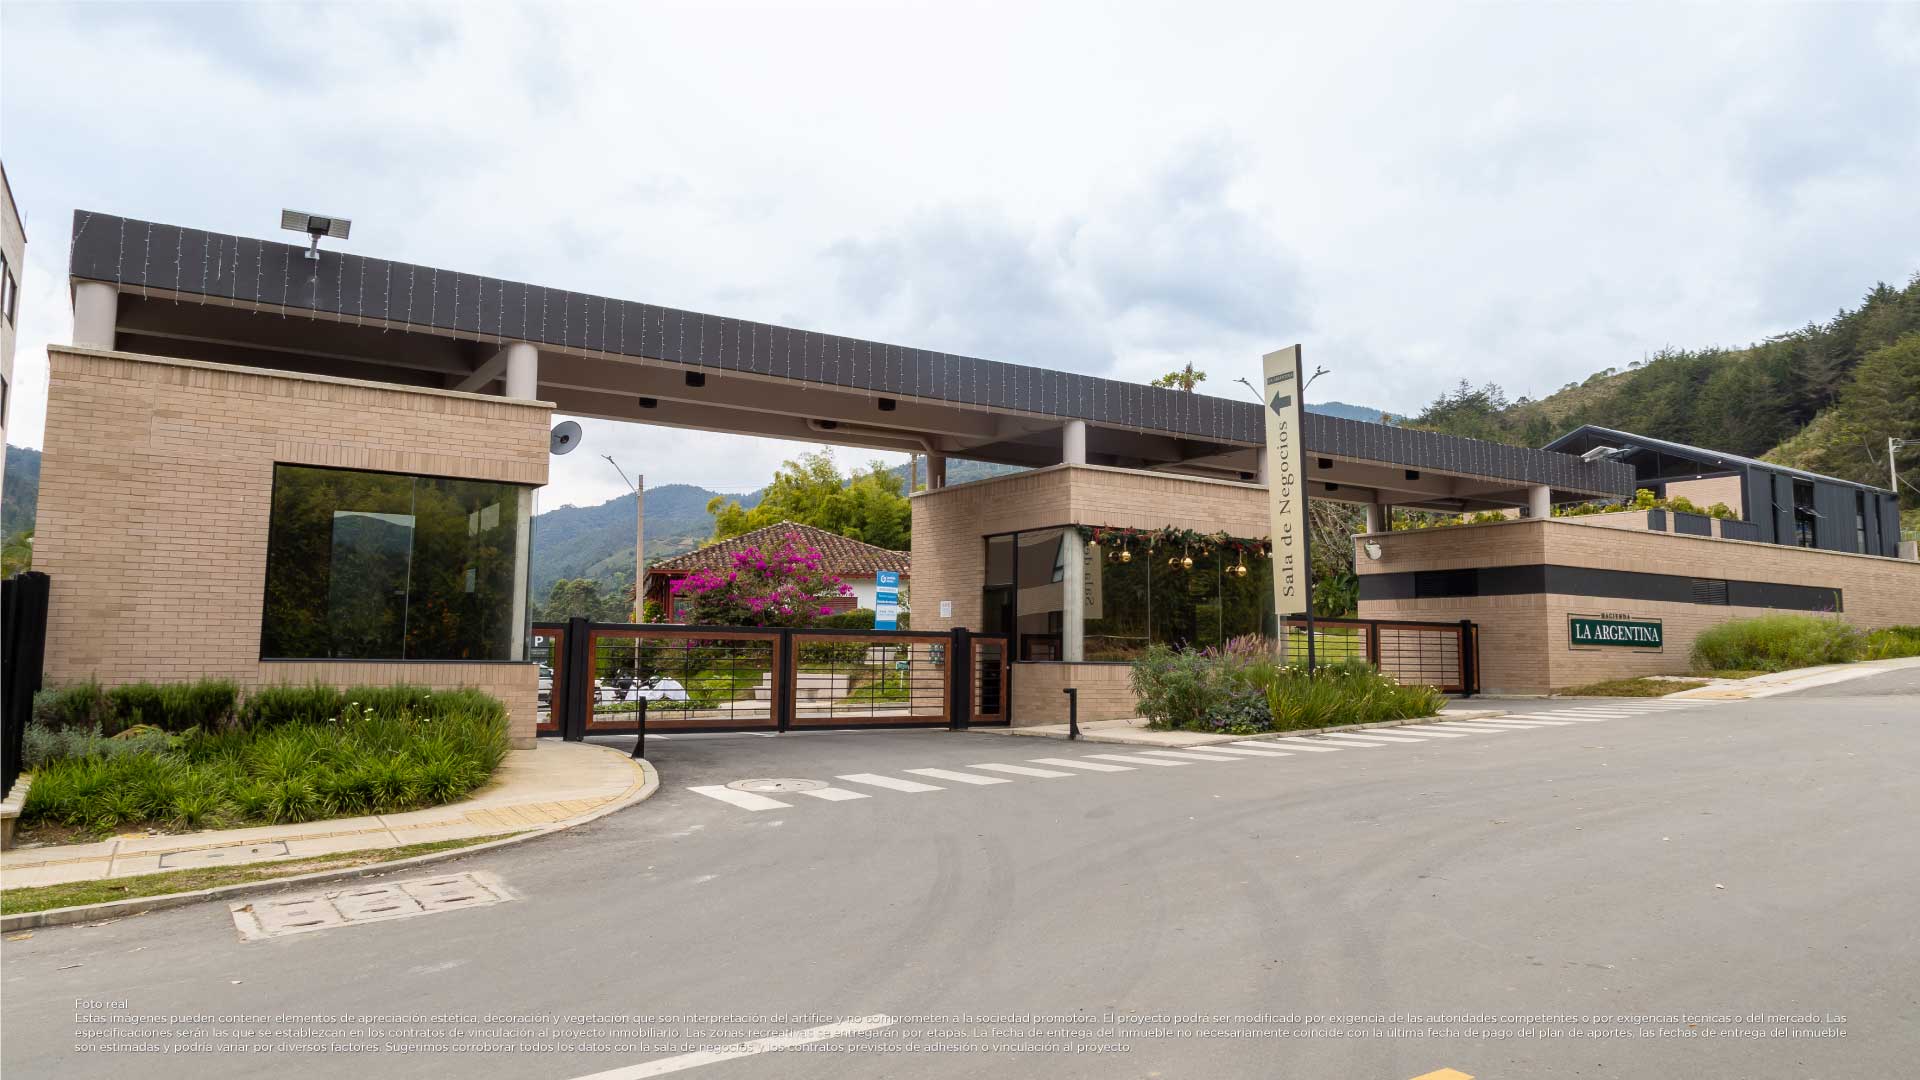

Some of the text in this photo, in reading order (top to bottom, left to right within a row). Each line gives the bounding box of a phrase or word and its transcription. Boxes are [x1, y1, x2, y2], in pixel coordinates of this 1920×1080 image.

[1278, 420, 1295, 597] Sala de Negocios
[1601, 612, 1631, 620] HACIENDA
[1576, 624, 1660, 642] LA ARGENTINA
[534, 635, 544, 648] P
